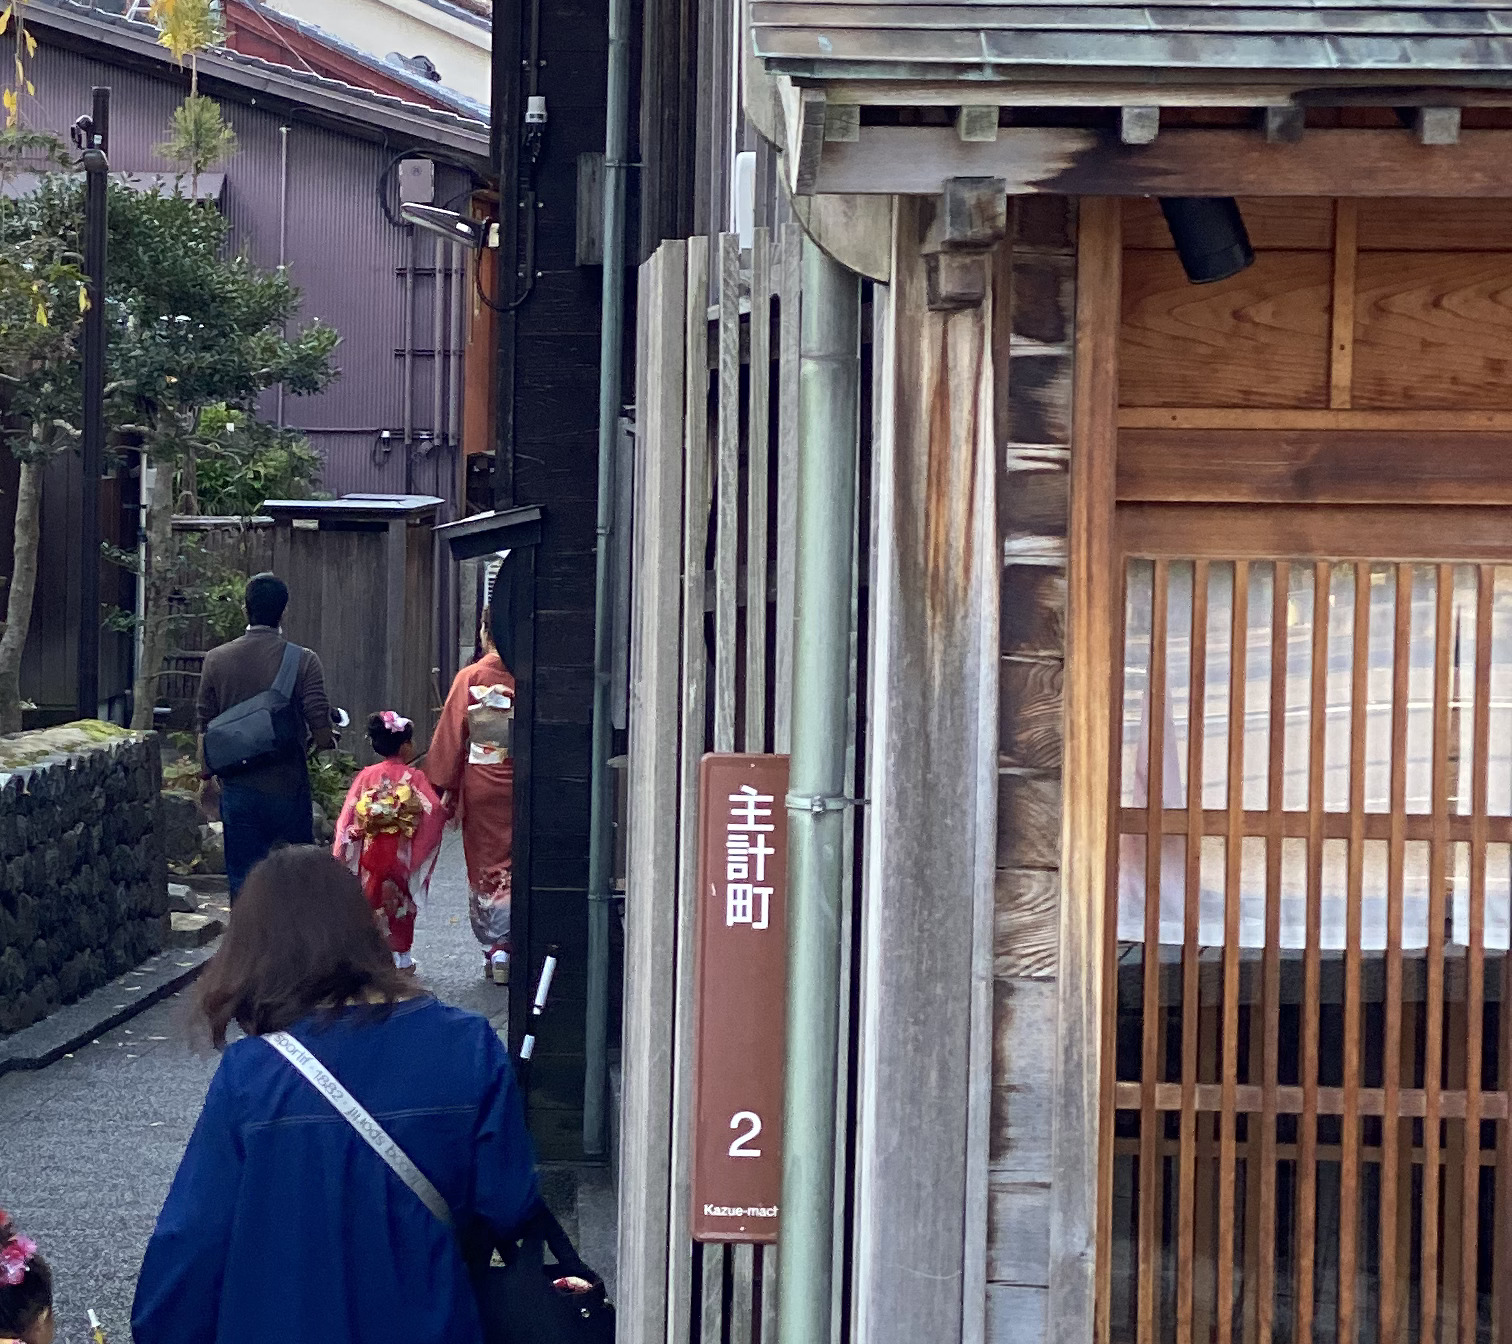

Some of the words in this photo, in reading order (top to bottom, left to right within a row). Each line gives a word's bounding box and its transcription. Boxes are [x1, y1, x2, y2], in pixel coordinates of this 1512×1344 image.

[725, 784, 776, 930] 主計町
[314, 1069, 344, 1103] 1882
[728, 1110, 763, 1158] 2
